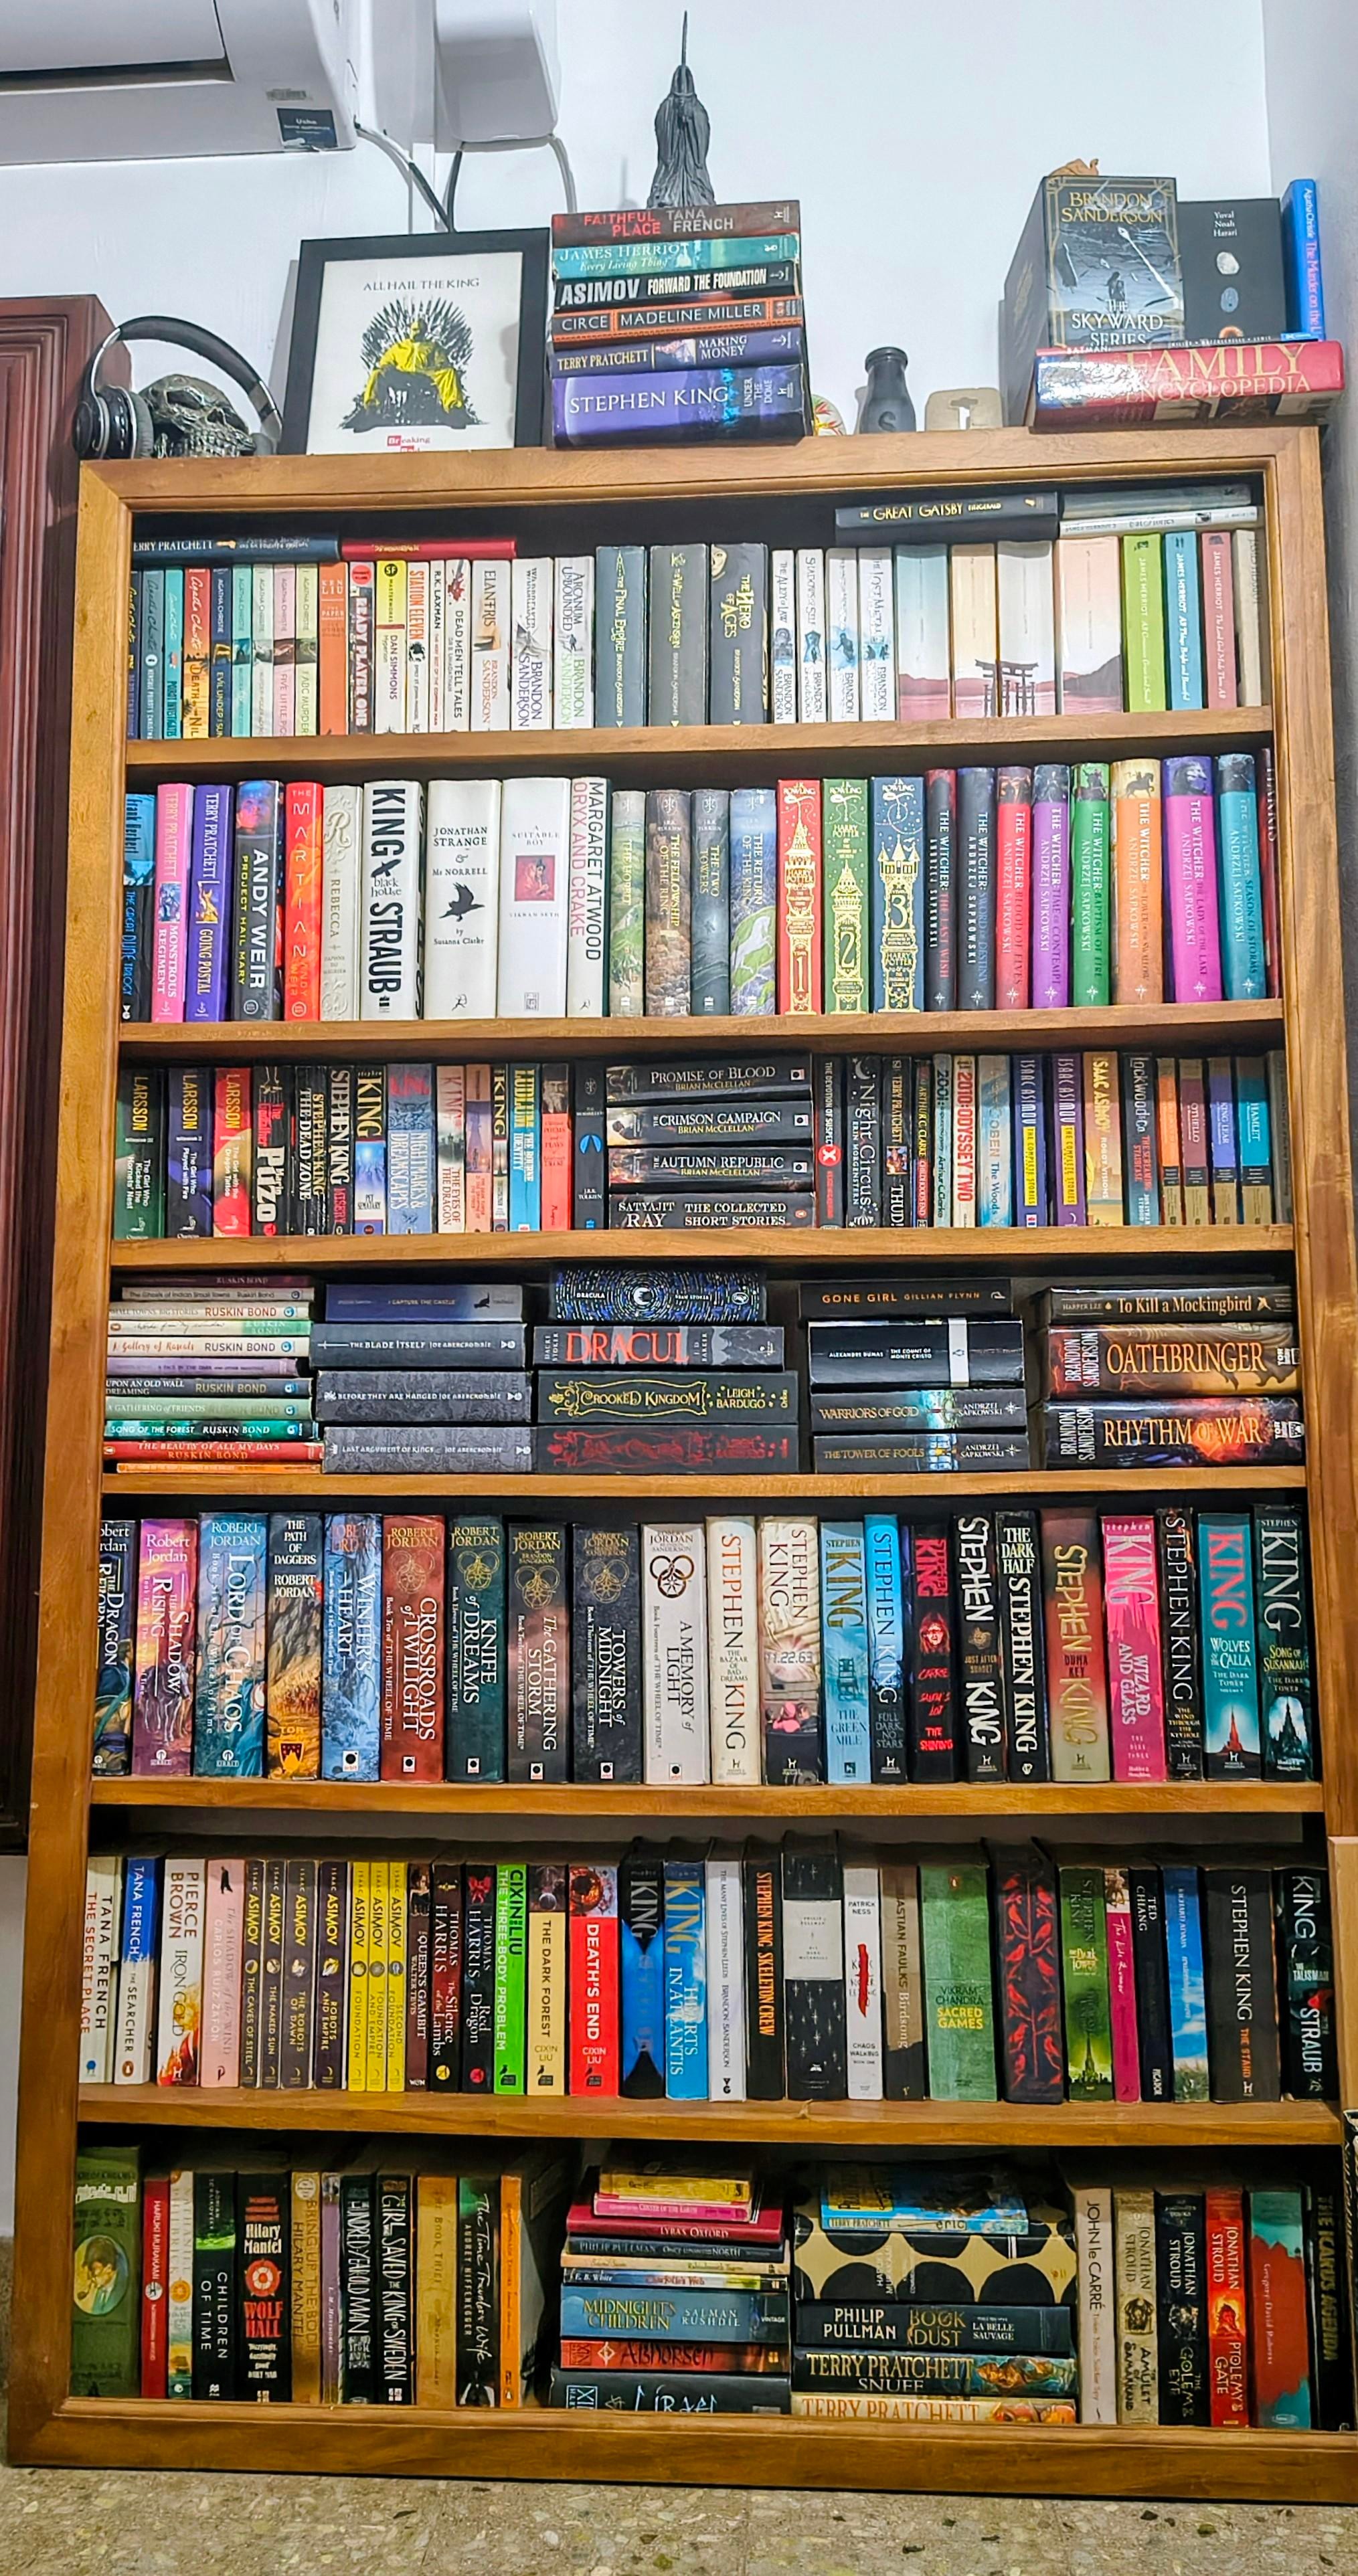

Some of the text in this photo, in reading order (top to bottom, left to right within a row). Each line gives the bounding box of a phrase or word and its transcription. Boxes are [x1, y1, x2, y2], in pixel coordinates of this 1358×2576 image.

[1070, 191, 1153, 208] BRANDON
[584, 213, 655, 225] FAITHFUL
[667, 209, 705, 220] TANA
[1062, 207, 1162, 224] SANDERSON
[1214, 211, 1234, 219] Yuval
[1214, 220, 1235, 229] Noah
[612, 221, 661, 238] PLACE
[673, 219, 734, 233] FRENCH
[1213, 229, 1238, 238] Harari
[363, 278, 479, 291] ALL HAIL THE KING
[560, 268, 767, 305] ASIMOV FORWARD THE FOUNDATION
[562, 304, 762, 332] CIRCE MADELINE MILLER
[1072, 313, 1163, 331] SKYWARD
[699, 336, 747, 348] MAKING
[701, 345, 745, 359] MONEY
[558, 350, 648, 371] TERRY PRATCHETT
[1127, 343, 1306, 380] FAMILY
[1126, 375, 1311, 402] ENCYCLOPEDIA
[570, 387, 729, 413] STEPHEN KING
[873, 503, 963, 521] GREAT GATSBY
[390, 634, 398, 700] DAN SIMMONS
[518, 654, 529, 727] SANDERSON
[371, 789, 406, 856] KING
[1140, 802, 1150, 824] THE
[434, 826, 488, 837] JONATHAN
[434, 837, 487, 846] STRANGE
[445, 868, 488, 876] NORRELL
[585, 781, 604, 961] MARGARET ATWOOD
[371, 887, 402, 897] house
[374, 877, 399, 888] black
[330, 879, 341, 938] REBECCA
[238, 856, 249, 984] PROJECT HAIL MARY
[250, 849, 269, 989] ANDY WEIR
[369, 902, 404, 994] STRAUB
[197, 929, 213, 994] GOING POSTAL
[651, 1067, 776, 1084] PROMISE OF BLOOD
[133, 1077, 148, 1131] LARSSON
[182, 1075, 197, 1130] LARSSON
[226, 1075, 240, 1129] LARSSON
[659, 1111, 781, 1126] CRIMSON CAMPAIGN
[678, 1125, 703, 1134] BRIAN
[661, 1157, 784, 1168] AUTUMN REPUBLIC
[957, 1109, 973, 1201] ODYSSEY TWO
[390, 1133, 408, 1210] DREAMSCAPES
[256, 1146, 285, 1221] Puzo
[618, 1202, 675, 1212] SATYAJIT
[685, 1203, 786, 1212] THE COLLECTED
[890, 1185, 904, 1226] THUD!
[626, 1214, 666, 1227] RAY
[685, 1216, 786, 1226] SHORT STORIES
[822, 1295, 860, 1303] GONE
[867, 1293, 897, 1302] GIRL
[1117, 1295, 1252, 1315] To Kill a Mockingbird
[205, 1308, 276, 1316] RUSKIN BOND
[566, 1331, 689, 1363] DRACUL
[1065, 1339, 1081, 1382] BRANDON
[1082, 1333, 1100, 1387] SANDERSON
[1107, 1342, 1267, 1374] OATHBRINGER
[580, 1391, 700, 1406] CROOKED KINGDOM
[717, 1399, 765, 1408] BARDUGO
[726, 1389, 755, 1398] LEIGH
[1104, 1418, 1263, 1446] RHYTHM OF WAR
[147, 1534, 189, 1547] Robert
[147, 1550, 188, 1564] Jordan
[274, 1555, 316, 1564] DAGGERS
[1001, 1544, 1035, 1558] DARK
[1003, 1558, 1035, 1574] HALF
[722, 1536, 743, 1648] STEPHEN
[1210, 1637, 1250, 1652] WOLVES
[419, 1596, 437, 1740] CROSSROADS
[1220, 1652, 1251, 1666] CALLA
[402, 1614, 419, 1734] TWILIGHT
[529, 1649, 542, 1716] STORM
[599, 1627, 612, 1728] MIDNIGHT
[667, 1647, 680, 1703] LIGHT
[725, 1685, 746, 1749] KING
[169, 1873, 183, 1938] BROWN
[185, 1873, 198, 1938] PIERCE
[509, 1869, 524, 1955] CIXIN LIU
[1231, 1885, 1252, 2020] STEPHEN KING
[586, 1924, 600, 2040] DEATH'S END
[542, 1948, 551, 2037] DARK FOREST
[758, 1952, 775, 2036] SKELETON CREW
[125, 1984, 137, 2052] SEARCHER
[937, 2007, 983, 2018] SACRED
[939, 2018, 983, 2029] GAMES
[1300, 2008, 1323, 2073] STRAUB
[246, 2223, 281, 2239] Hilary
[244, 2238, 282, 2254] Mantel
[1088, 2200, 1106, 2310] JOHN le CARRÉ
[1169, 2239, 1181, 2289] STROUD
[1182, 2231, 1197, 2295] JONATHAN
[217, 2272, 228, 2359] CHILDREN
[244, 2302, 283, 2319] WOLF
[685, 2309, 736, 2318] SALMAN
[834, 2308, 884, 2324] PHILIP
[245, 2319, 282, 2338] HALL
[823, 2323, 896, 2340] PULLMAN
[806, 2353, 974, 2379] TERRY PRATCHETT
[858, 2378, 924, 2391] SNUFF
